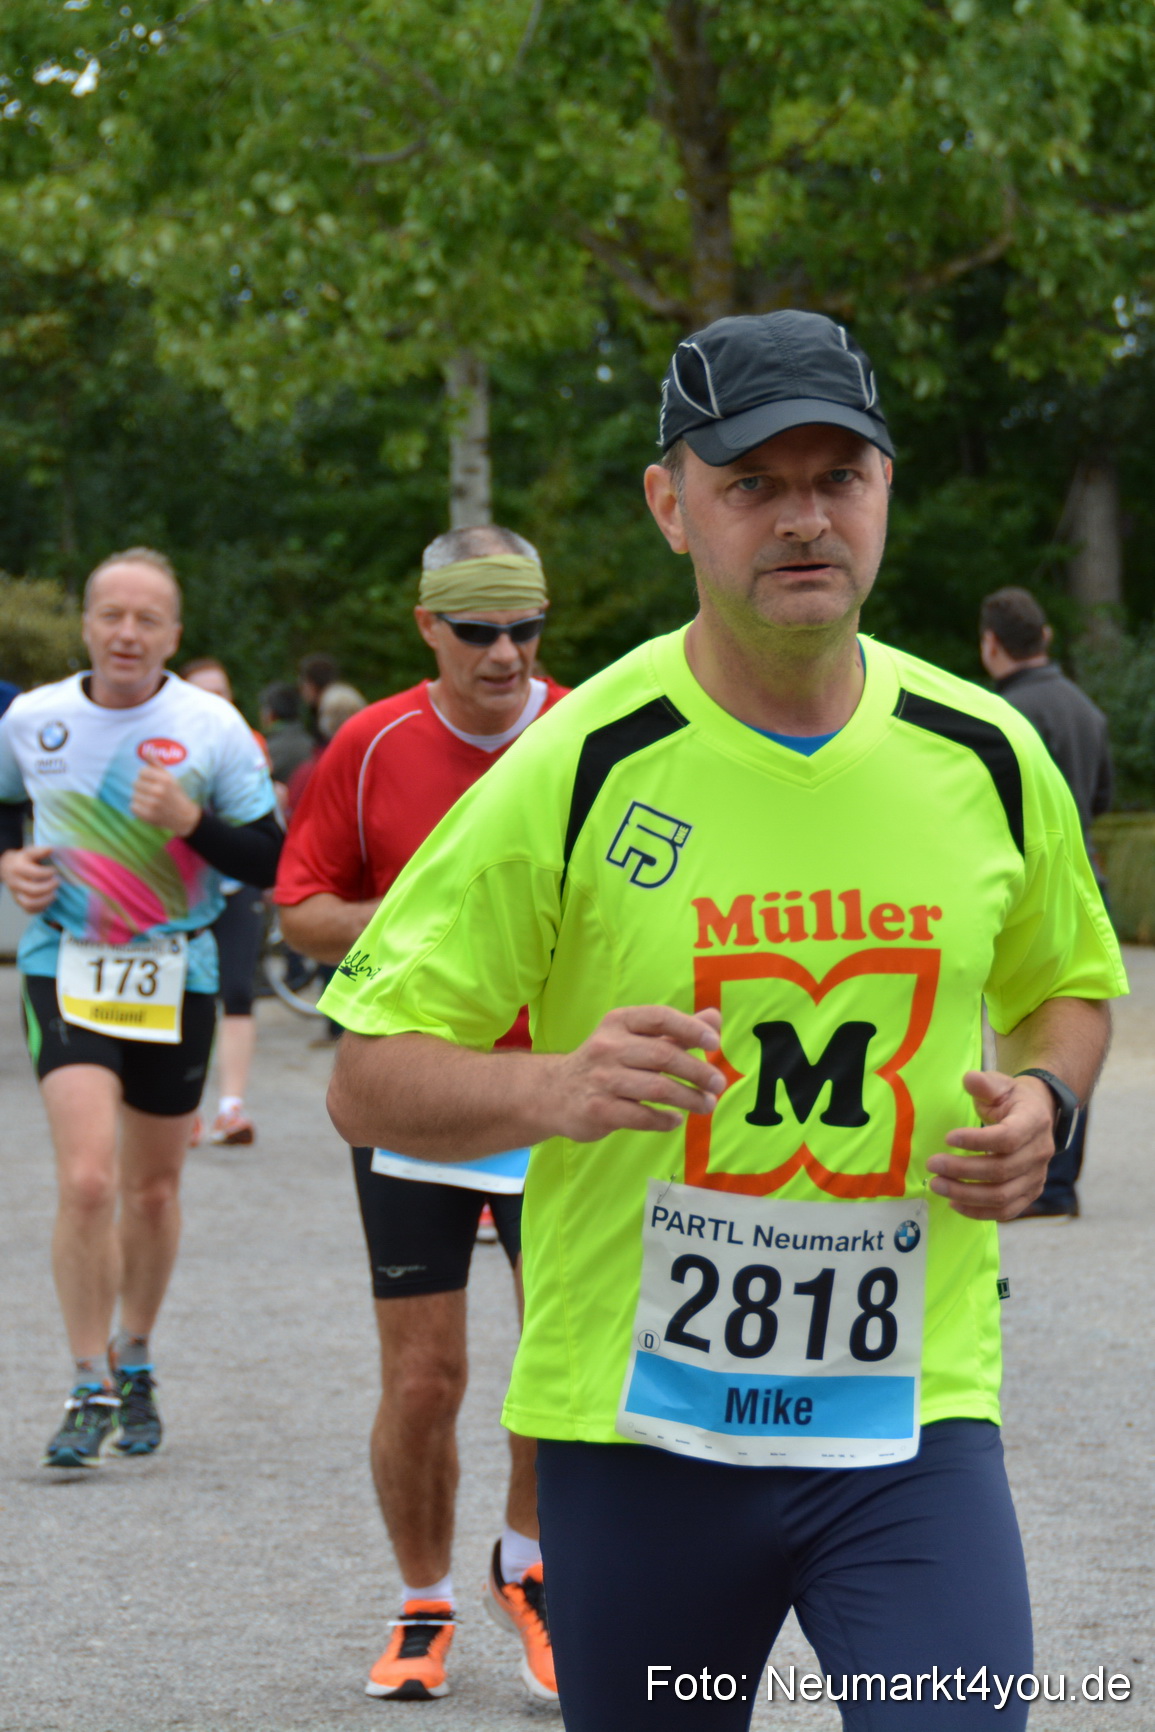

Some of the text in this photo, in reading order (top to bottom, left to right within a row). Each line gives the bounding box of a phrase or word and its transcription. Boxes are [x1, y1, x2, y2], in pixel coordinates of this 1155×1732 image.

[691, 889, 942, 949] Müller
[89, 957, 159, 998] 173
[745, 1020, 877, 1128] M
[651, 1205, 885, 1252] PARTL Neumarkt
[664, 1253, 899, 1362] 2818
[724, 1387, 813, 1425] Mike
